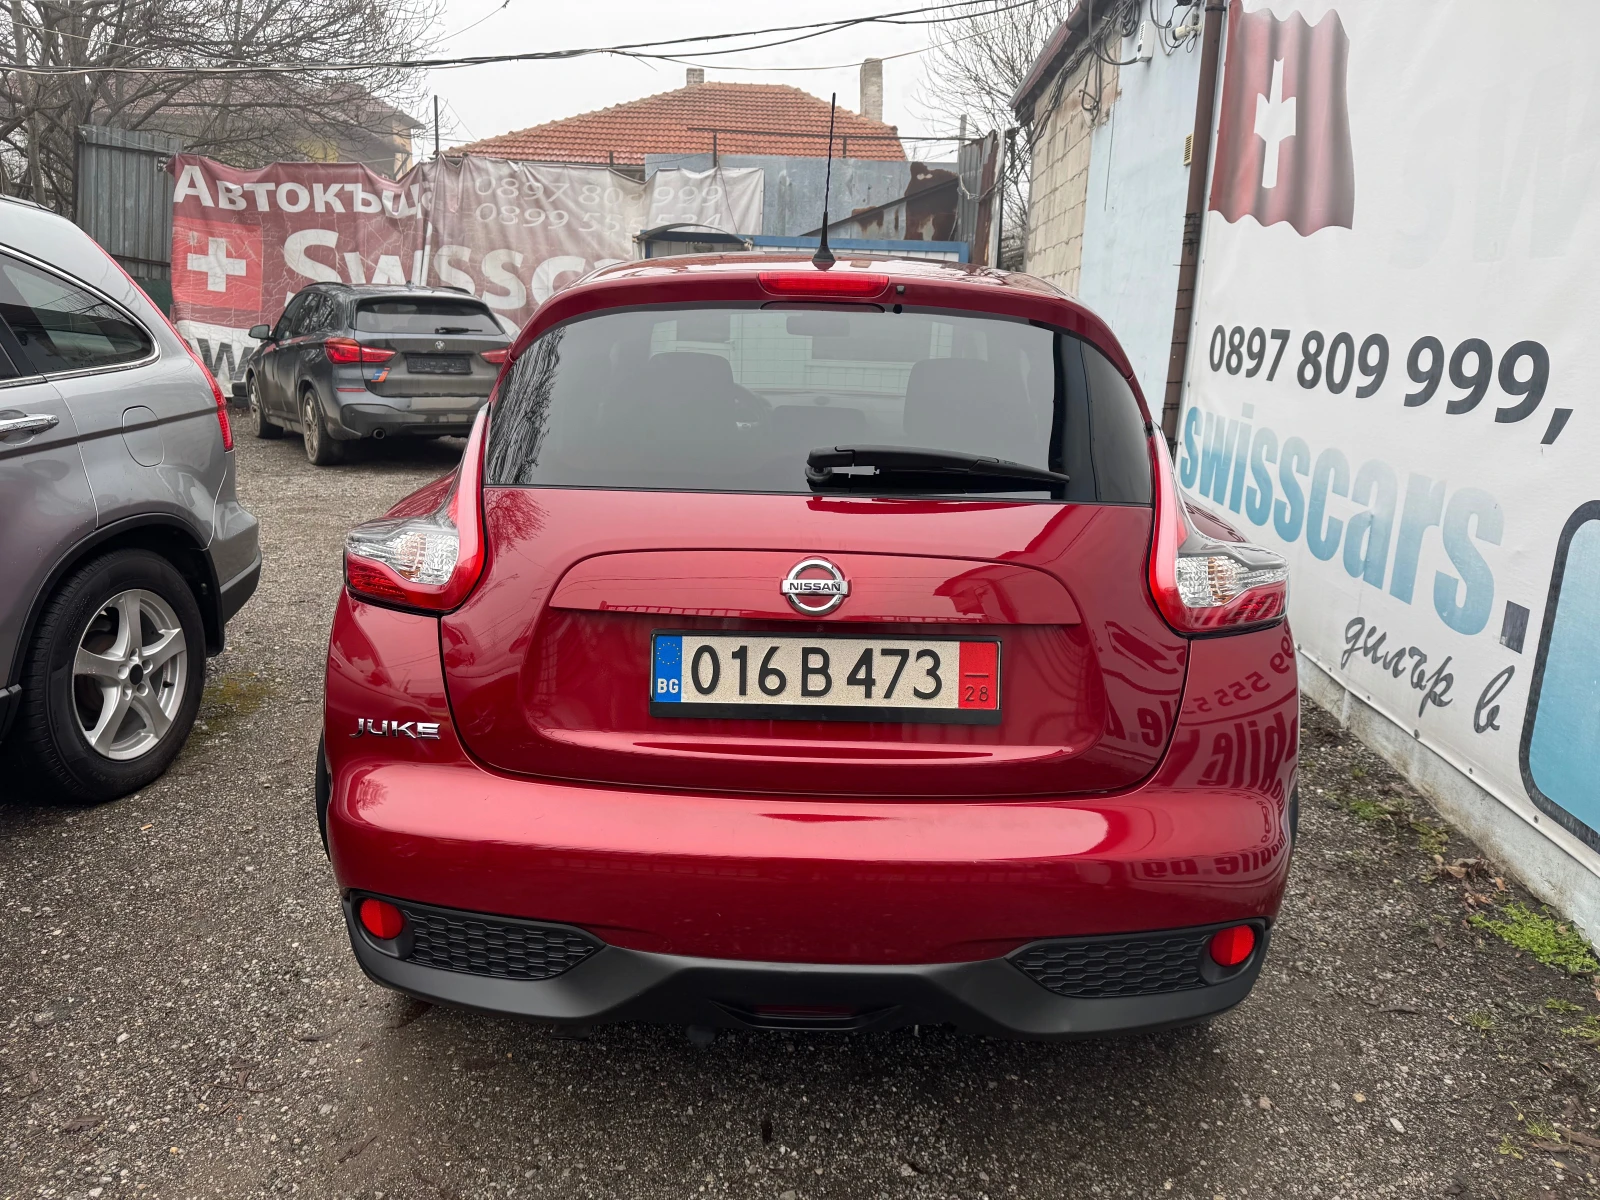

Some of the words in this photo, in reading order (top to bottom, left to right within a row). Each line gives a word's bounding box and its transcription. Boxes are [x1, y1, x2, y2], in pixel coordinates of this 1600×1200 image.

[475, 176, 569, 203] 0897
[652, 185, 722, 206] 999
[475, 202, 569, 229] 0899
[1209, 325, 1290, 381] 0897
[1297, 330, 1389, 399] 809
[1403, 335, 1574, 445] 999,
[789, 581, 842, 593] NISSAN
[657, 678, 680, 694] BG
[690, 645, 788, 697] 016
[801, 647, 833, 698] B
[846, 648, 943, 700] 473
[964, 686, 989, 703] 28
[349, 718, 441, 740] JUKE
